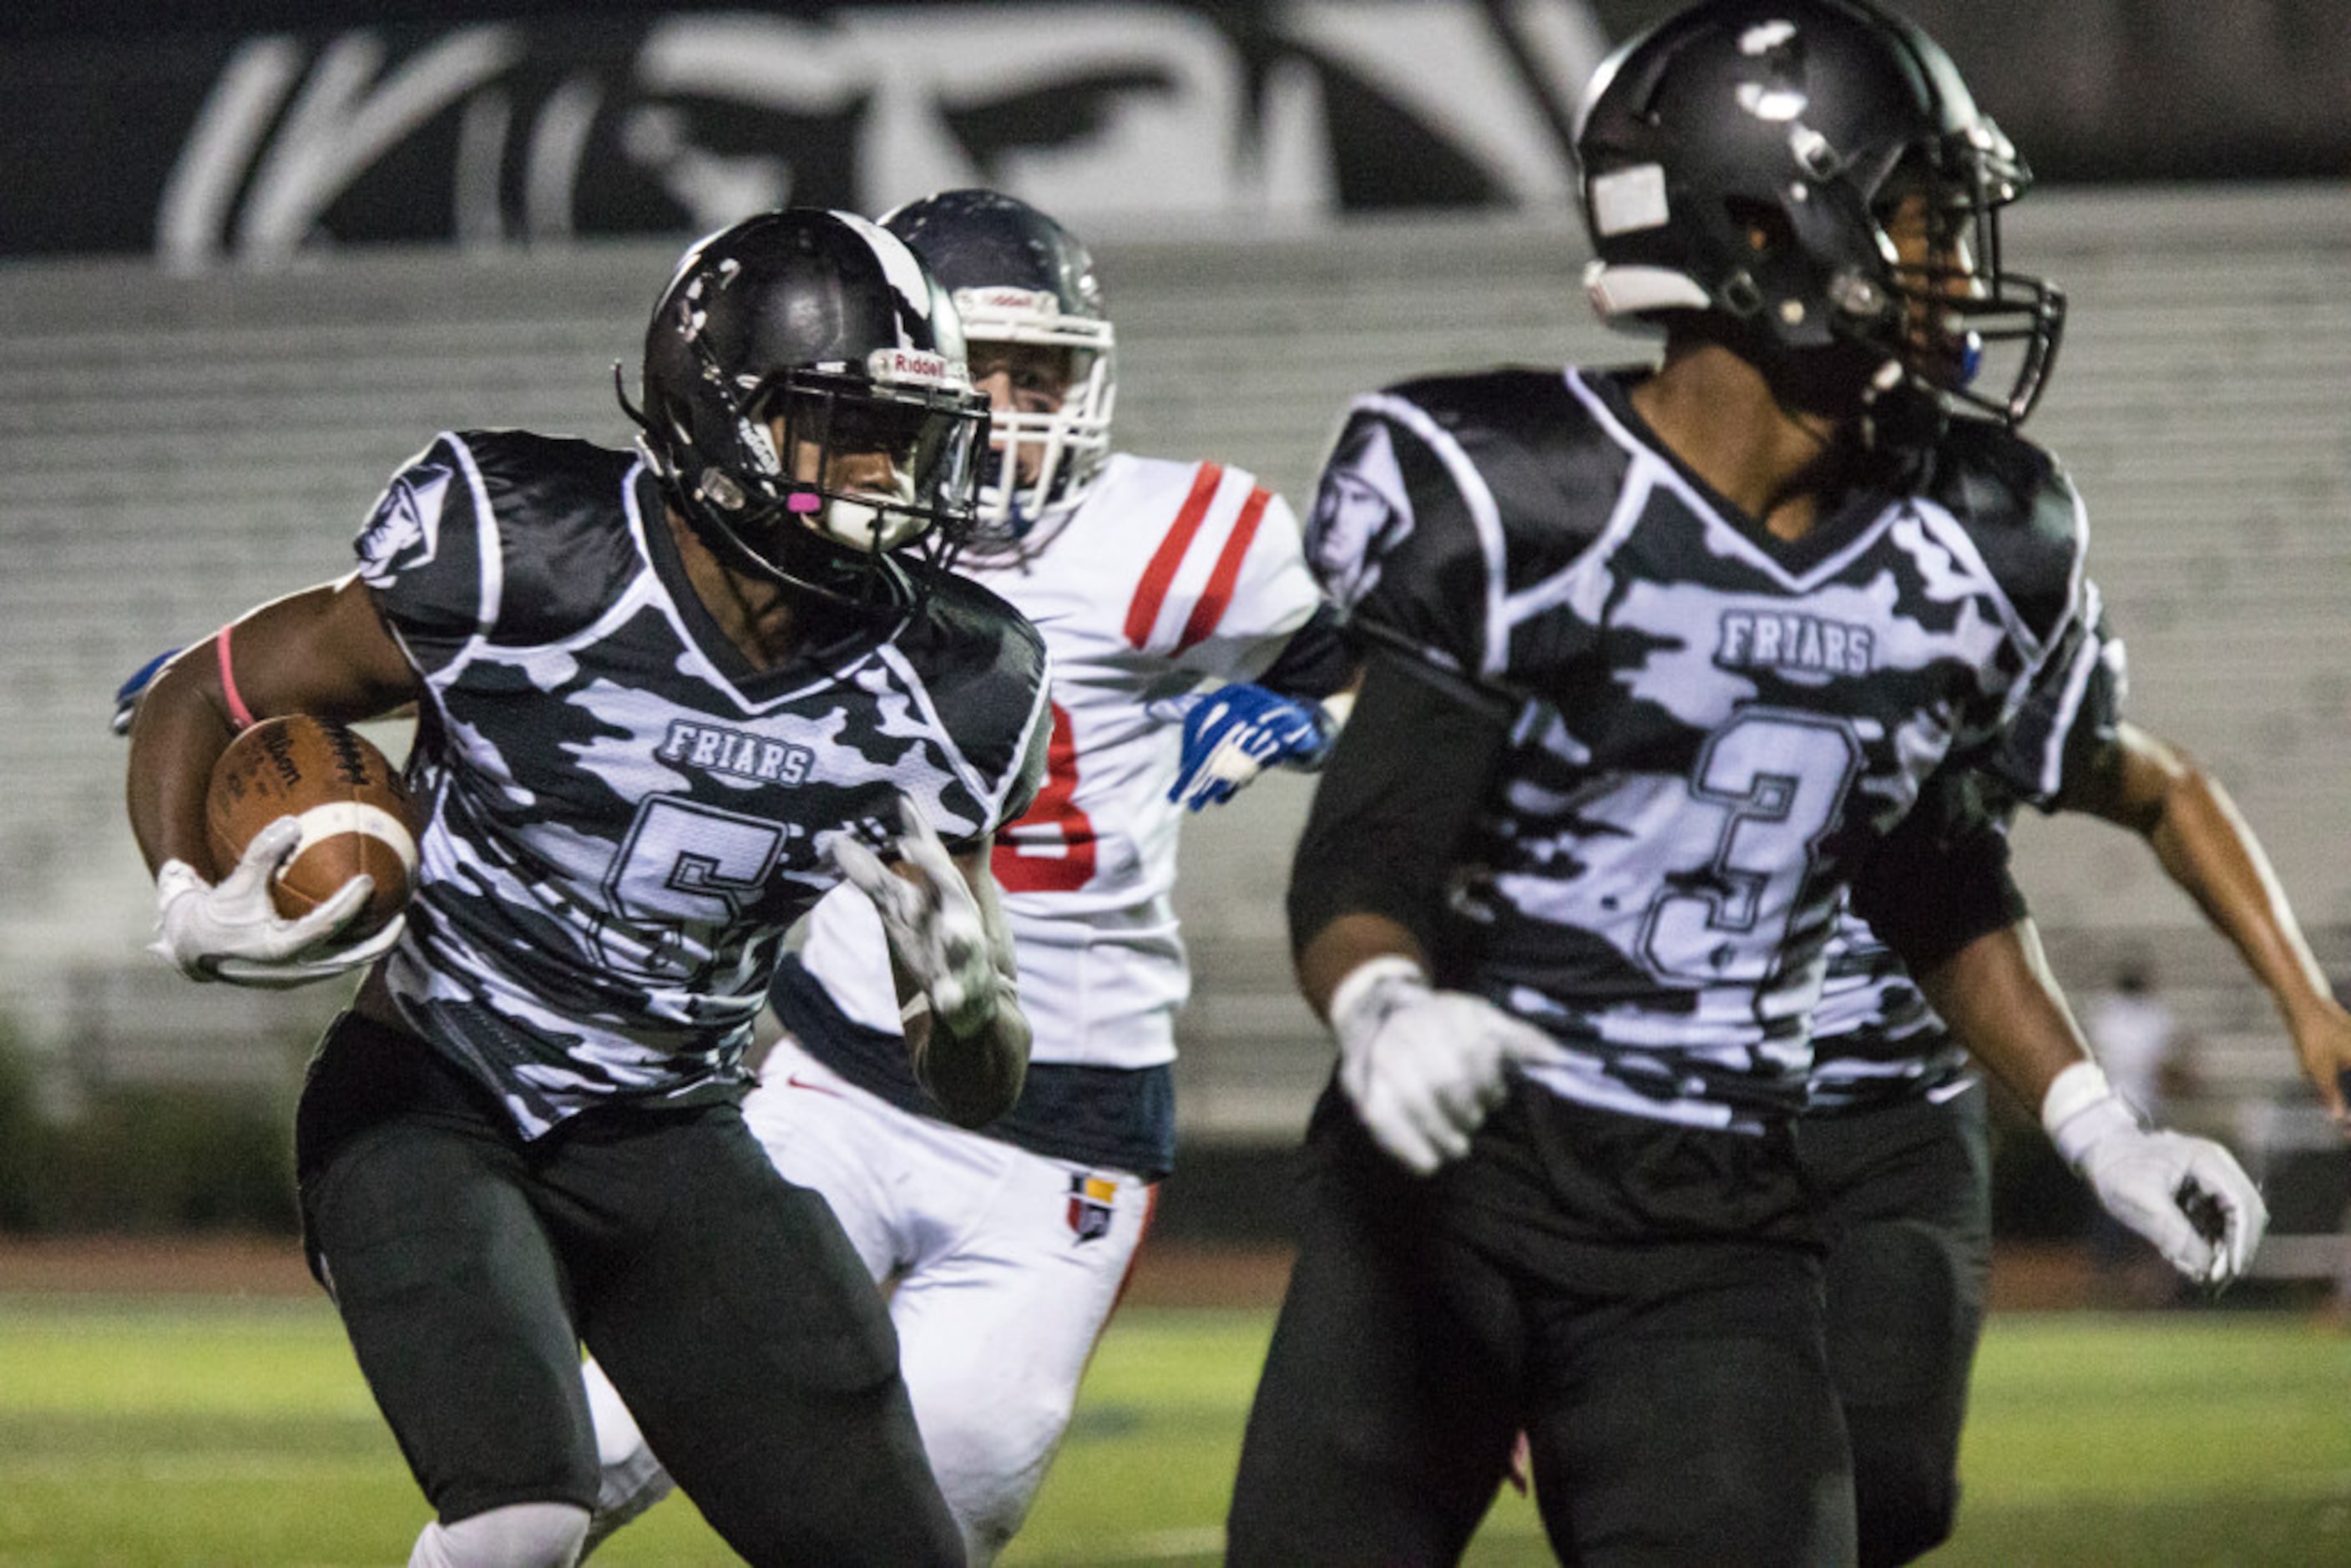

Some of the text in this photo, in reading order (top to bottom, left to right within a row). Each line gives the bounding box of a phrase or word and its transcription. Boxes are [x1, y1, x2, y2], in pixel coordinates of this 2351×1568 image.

[1716, 610, 1875, 676] FRIARS
[665, 718, 815, 787] FRIARS
[586, 793, 790, 987] 5
[1636, 701, 1865, 989] 3
